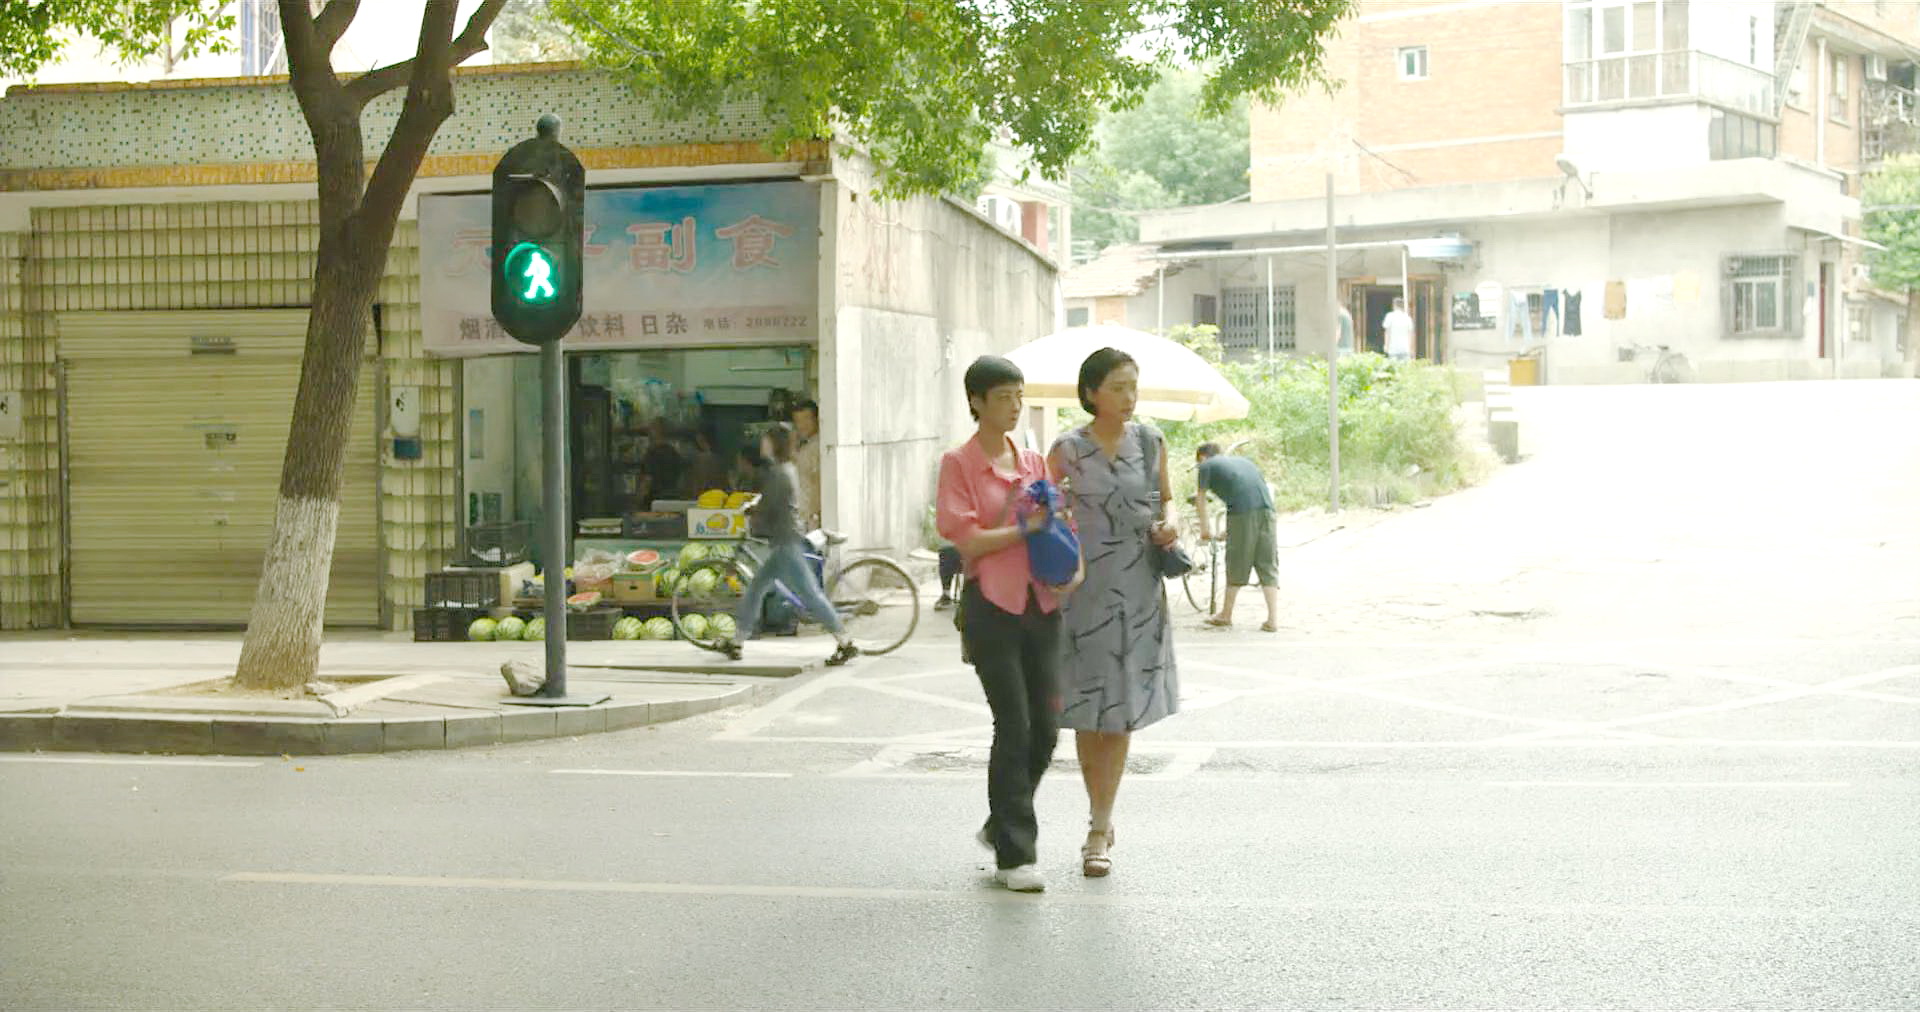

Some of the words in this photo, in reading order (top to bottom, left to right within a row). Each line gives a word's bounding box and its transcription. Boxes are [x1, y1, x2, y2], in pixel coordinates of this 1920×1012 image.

[445, 214, 792, 277] 元副食
[577, 314, 625, 338] 饮料
[641, 312, 689, 335] 日杂
